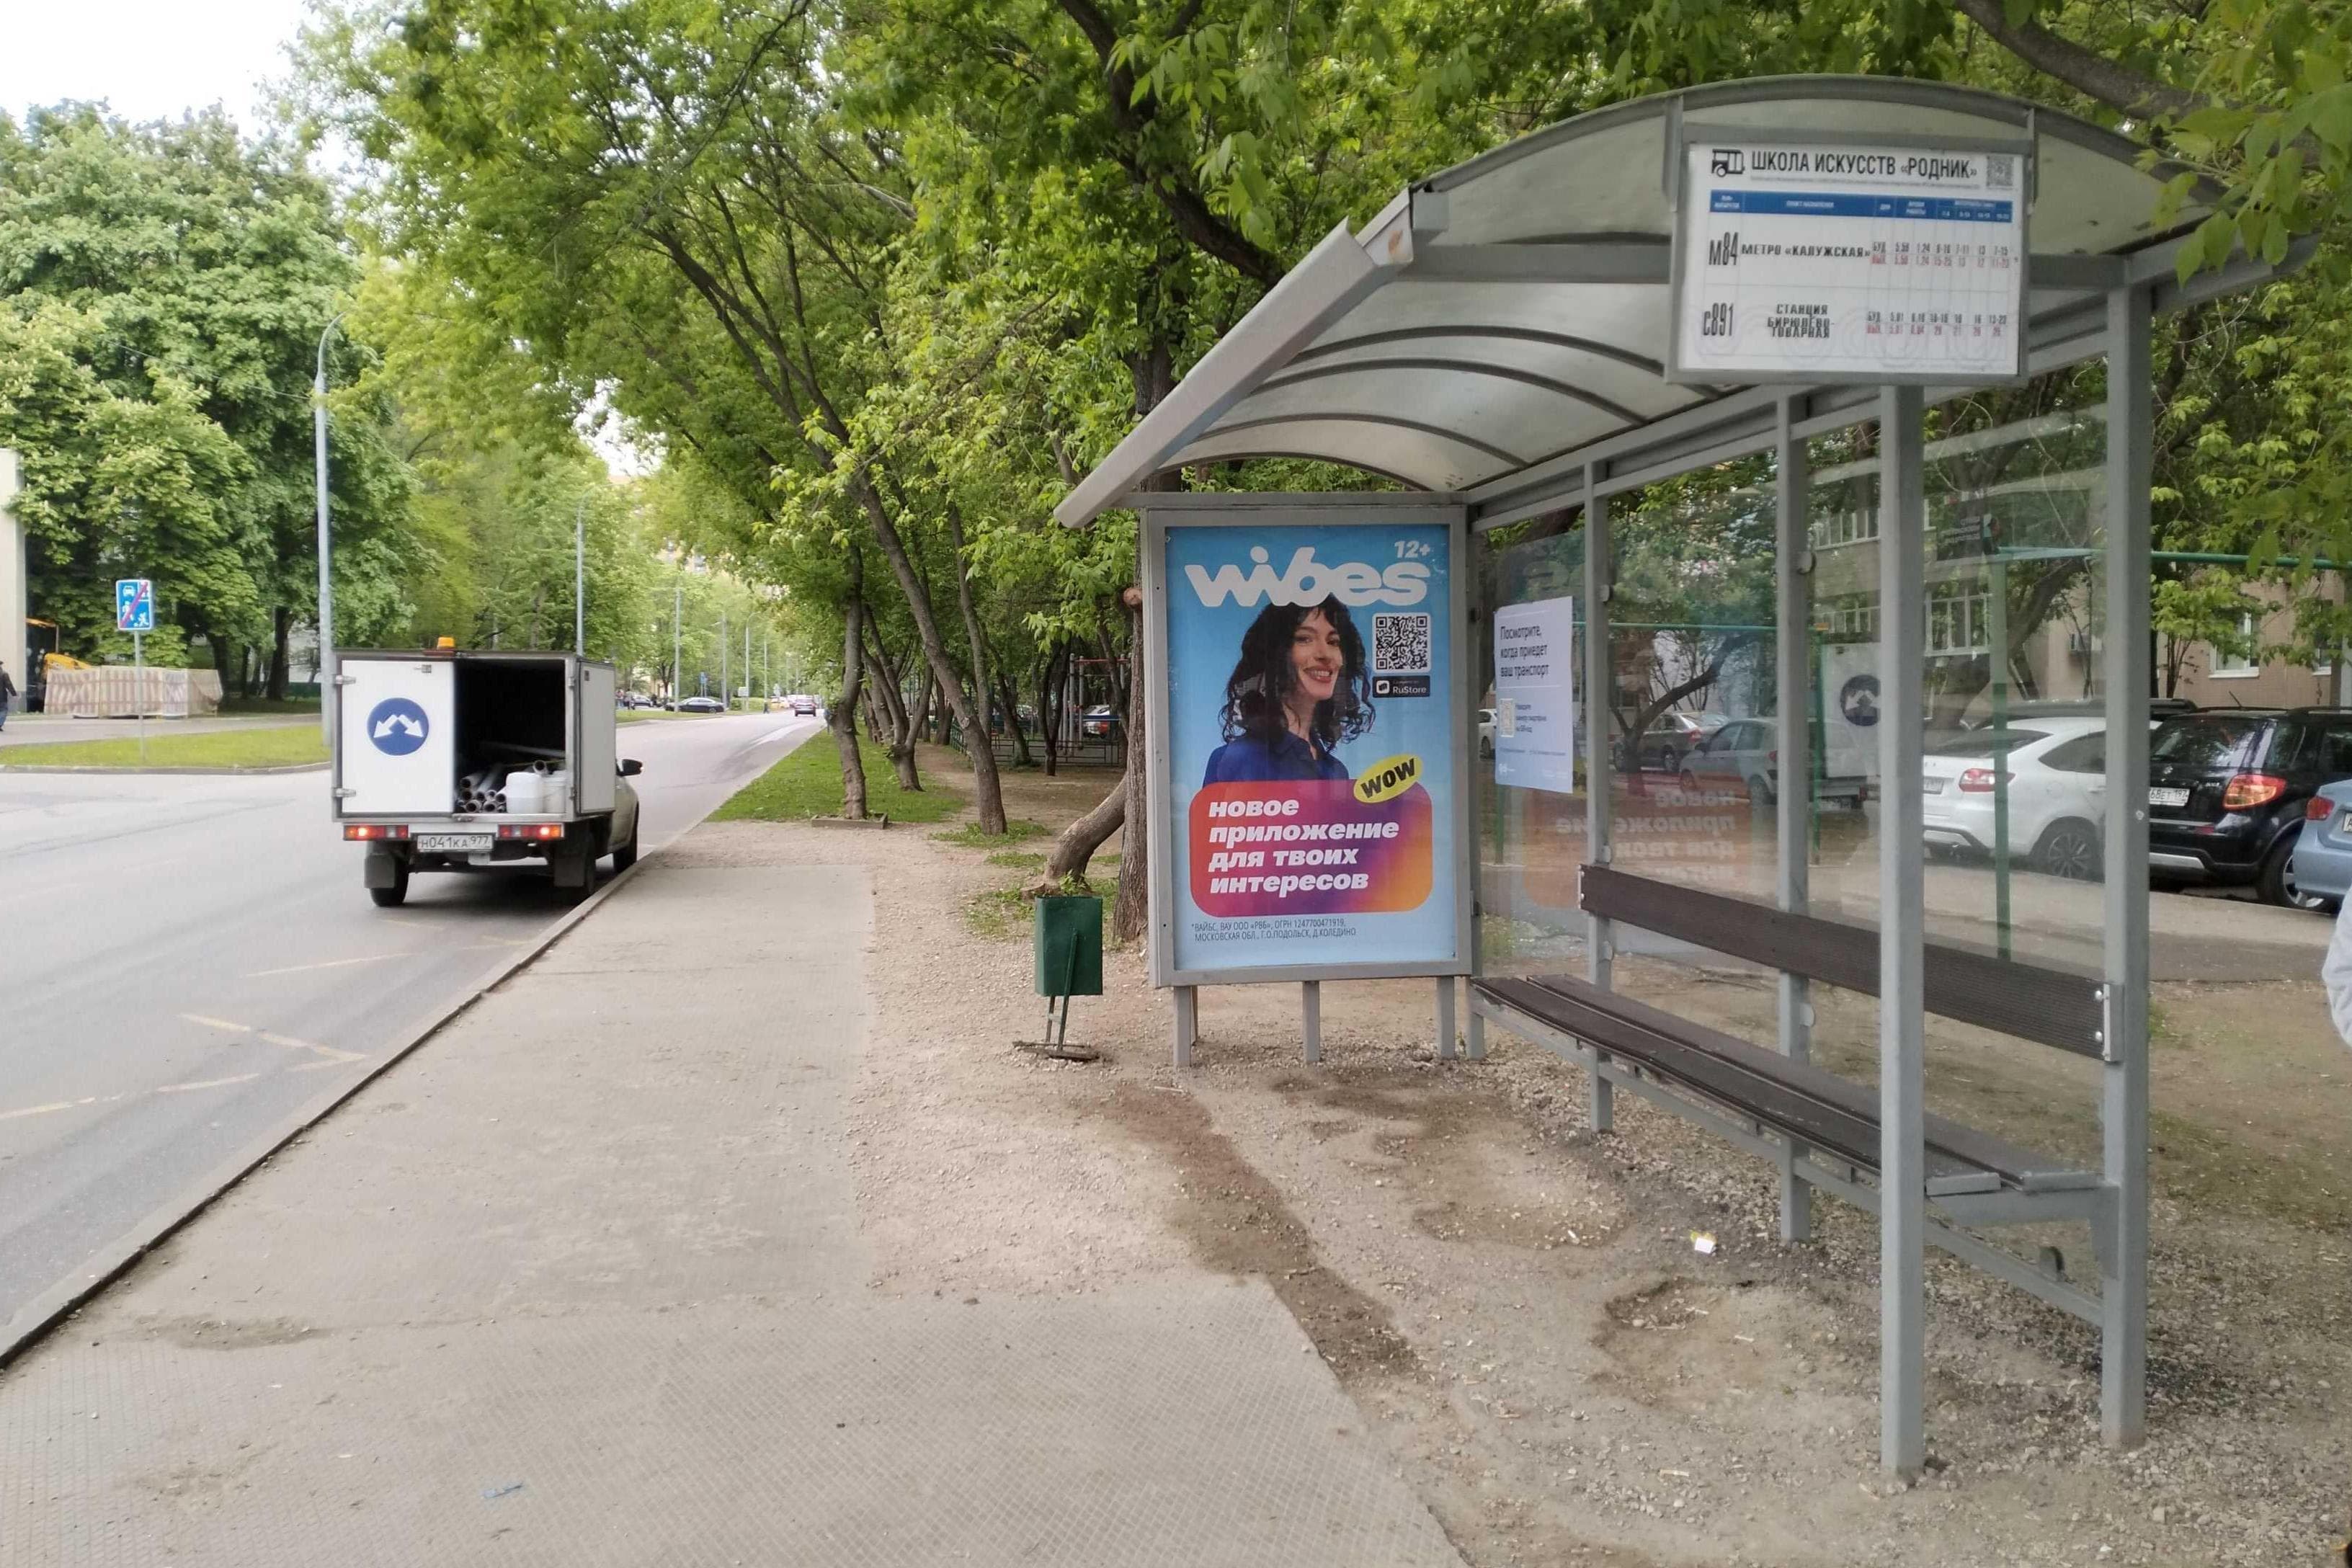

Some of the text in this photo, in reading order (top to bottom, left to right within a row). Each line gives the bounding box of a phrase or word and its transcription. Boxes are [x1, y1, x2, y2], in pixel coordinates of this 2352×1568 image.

[1751, 151, 1978, 179] ШКОЛА ИСКУССТВ «РОДНИК»
[1741, 244, 1871, 258] МЕТРО «КАЛУЖСКАЯ»
[1776, 303, 1828, 316] СТАНЦИЯ
[1394, 540, 1430, 558] 12+
[1184, 546, 1430, 607] wibes
[1208, 799, 1299, 818] новое
[471, 836, 489, 845] 977
[1208, 821, 1399, 849] приложение
[1207, 848, 1359, 873] для твоих
[1210, 873, 1369, 898] интересов
